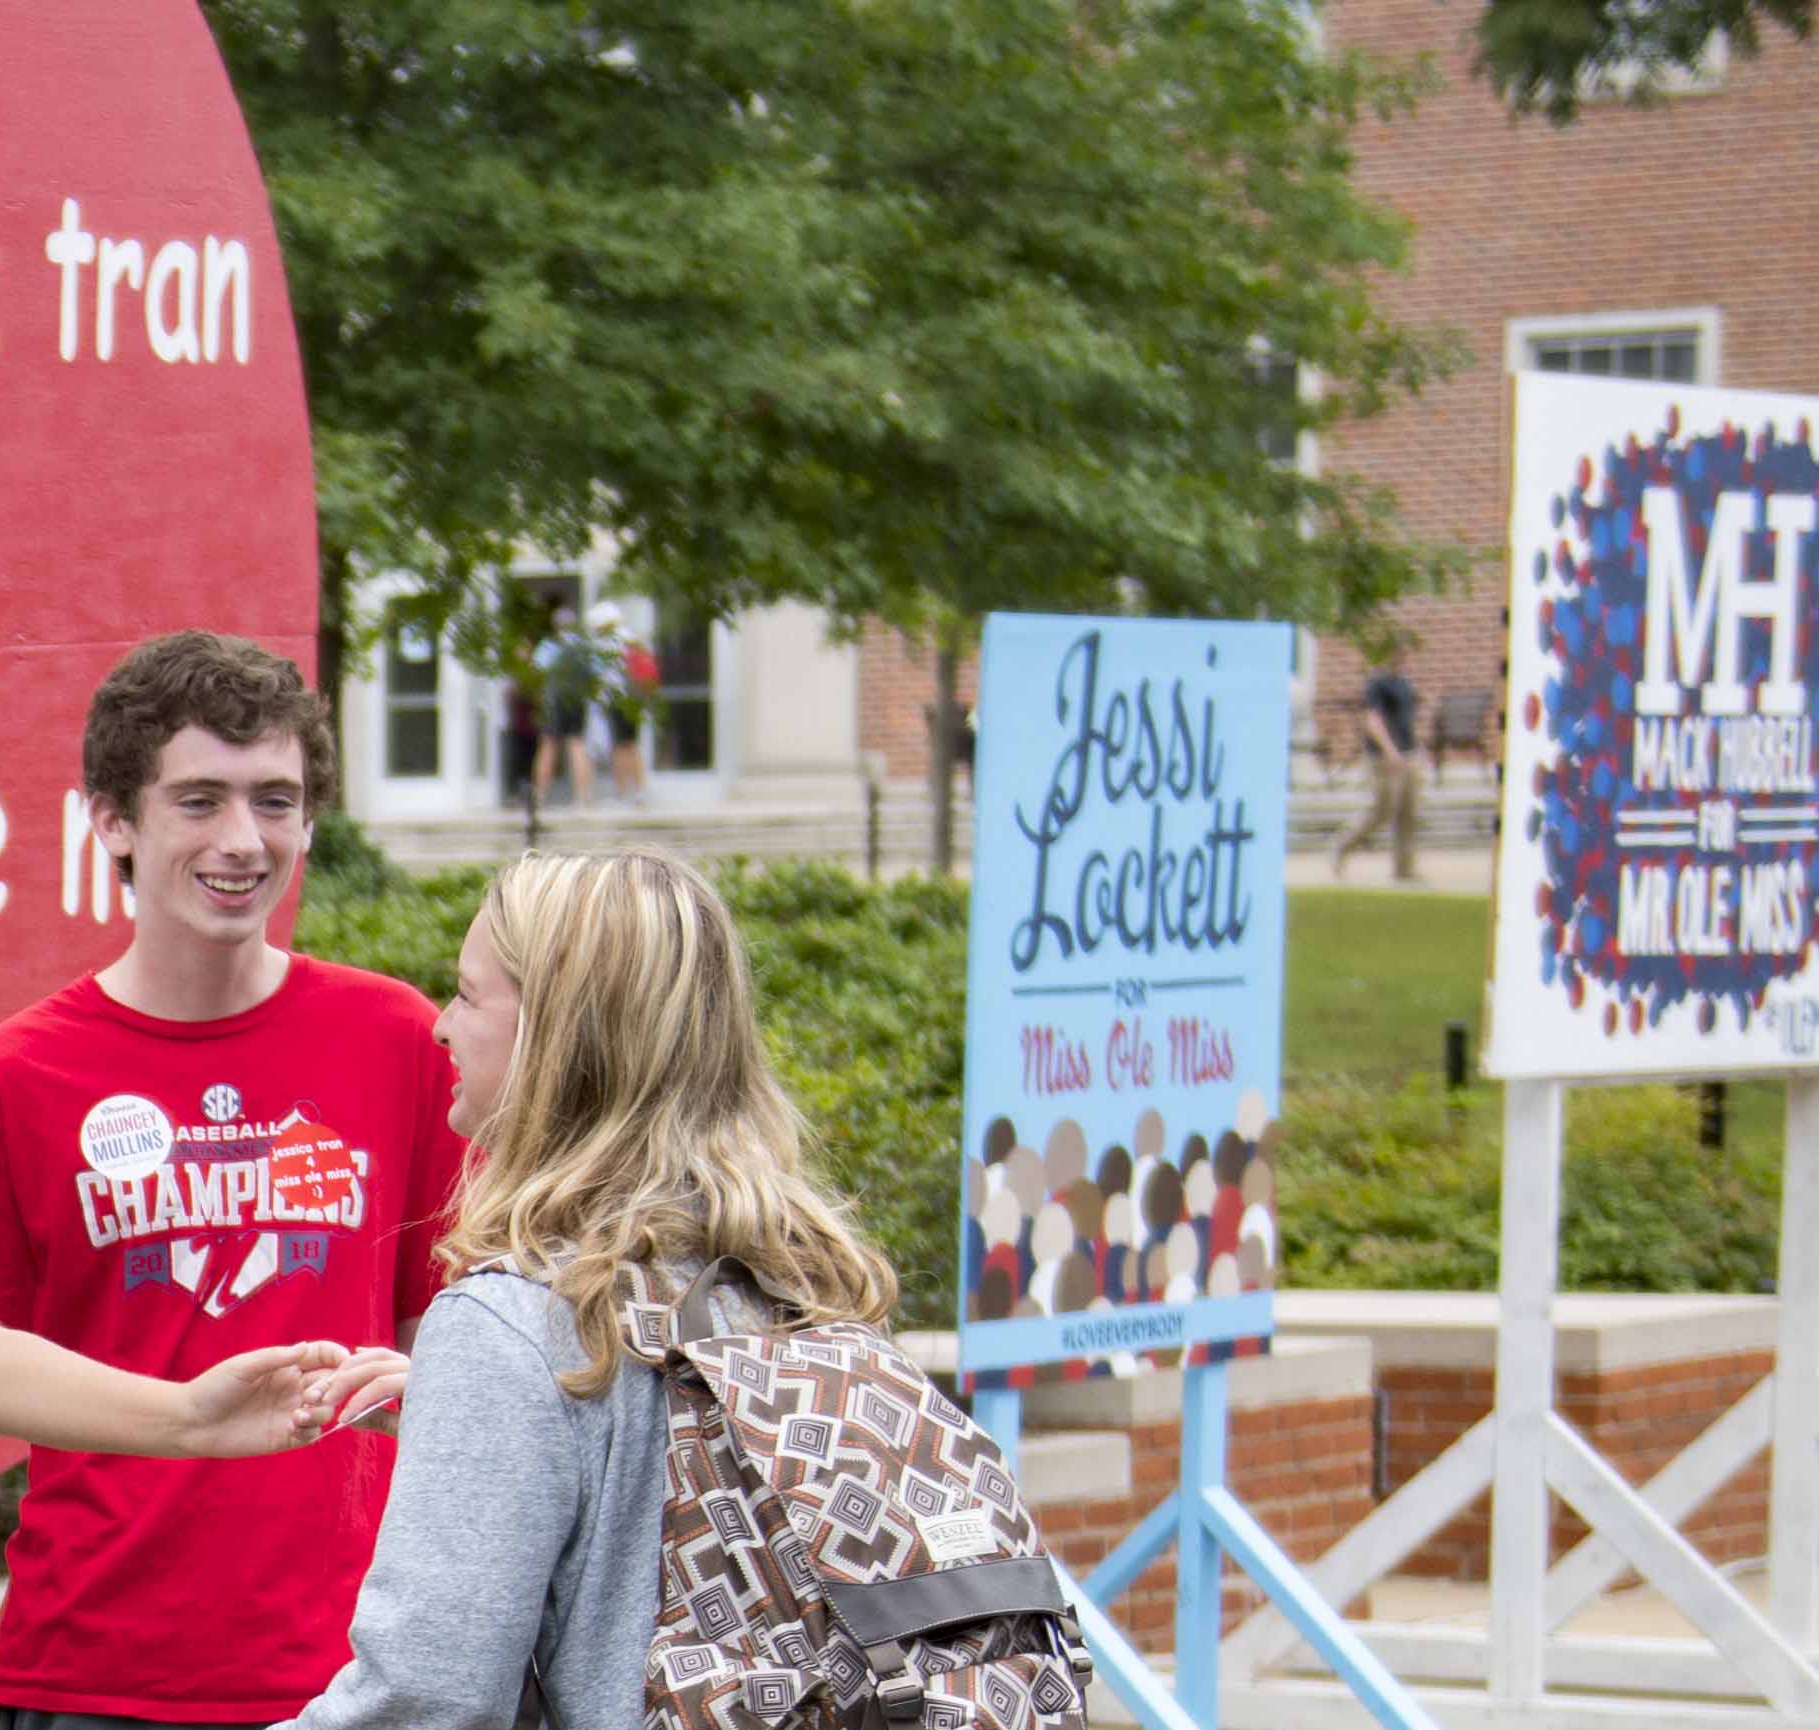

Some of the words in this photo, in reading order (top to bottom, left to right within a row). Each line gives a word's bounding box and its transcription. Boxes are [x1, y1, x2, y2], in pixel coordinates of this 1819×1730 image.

[45, 198, 250, 363] tran
[1045, 630, 1224, 824] Jessi
[1633, 716, 1711, 791] MACK
[1699, 799, 1736, 852] FOR
[1012, 795, 1254, 973] Lockett
[1677, 864, 1731, 956] OLE
[1739, 858, 1805, 954] MISS
[1021, 1022, 1091, 1098] Miss
[1106, 1014, 1154, 1091] Ole
[1167, 1014, 1234, 1087] Miss
[87, 1110, 157, 1140] CHAUNCEY
[173, 1122, 282, 1141] ASEBALL
[202, 1085, 241, 1121] SEC
[92, 1129, 164, 1161] MULLINS
[75, 1150, 368, 1249] CHAMPIS
[130, 1254, 161, 1275] 20
